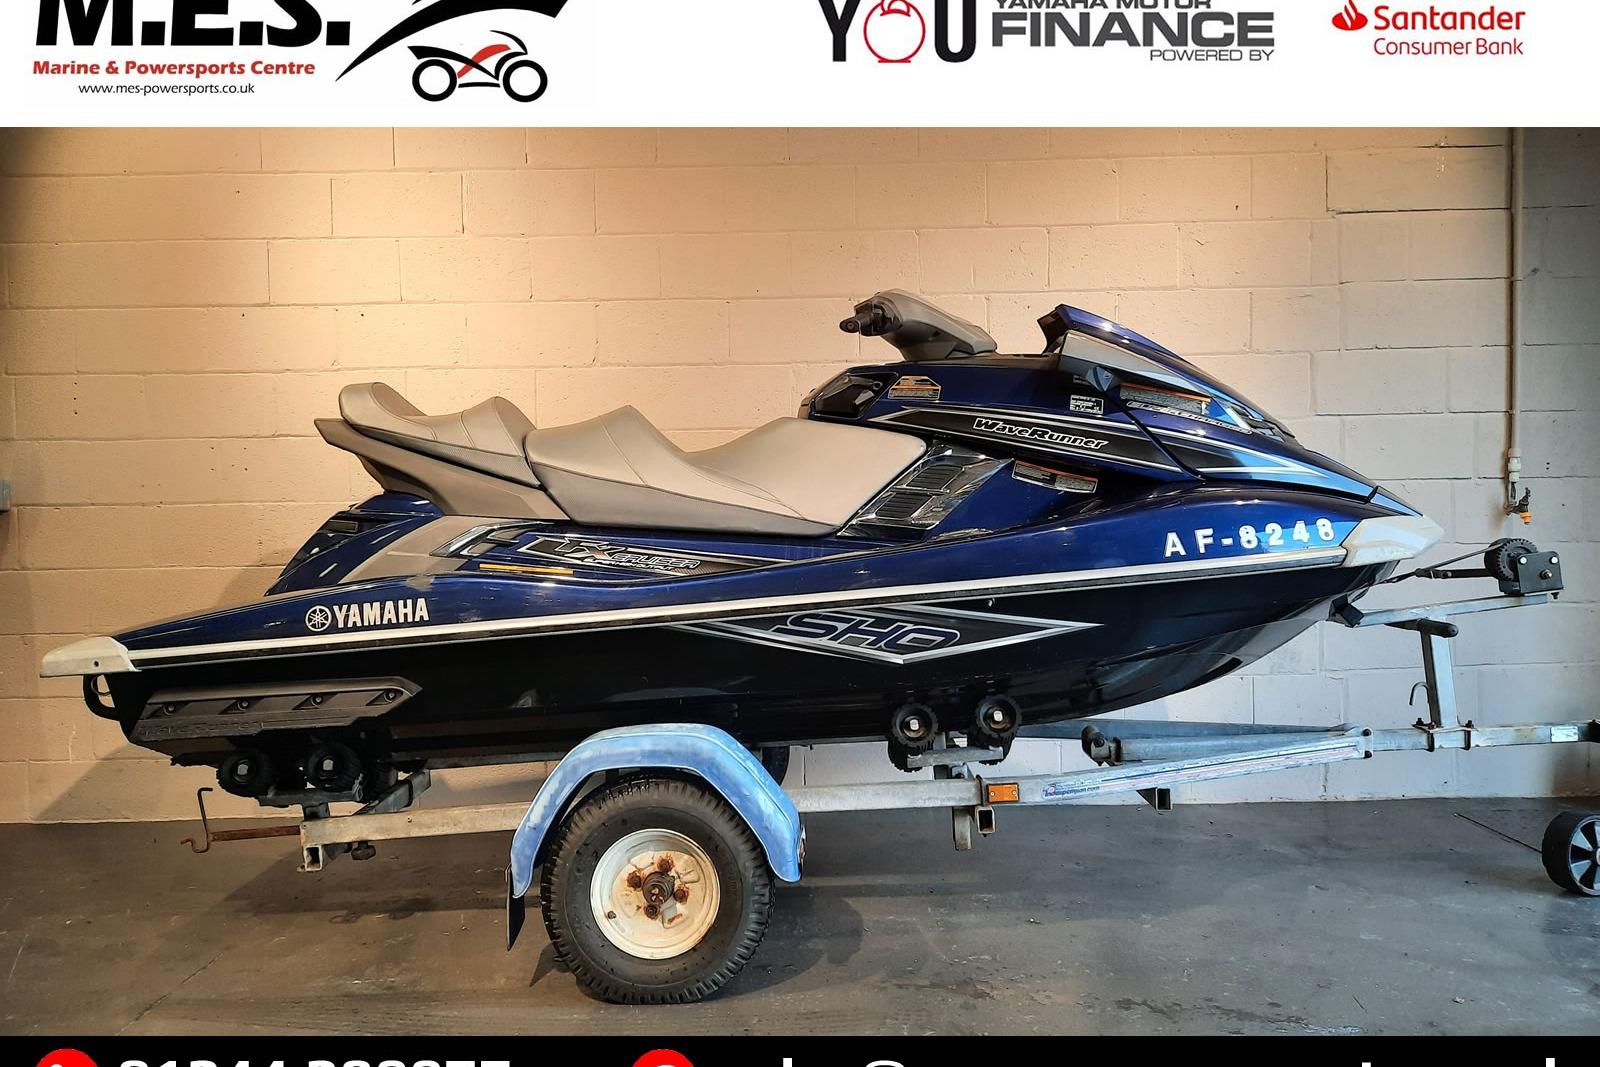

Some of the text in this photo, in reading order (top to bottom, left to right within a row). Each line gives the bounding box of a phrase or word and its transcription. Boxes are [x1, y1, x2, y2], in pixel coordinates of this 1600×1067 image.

[973, 418, 1108, 449] WaveRunner
[1165, 518, 1335, 558] AF-8248
[333, 598, 430, 628] YAMAHA
[769, 612, 960, 650] SHO
